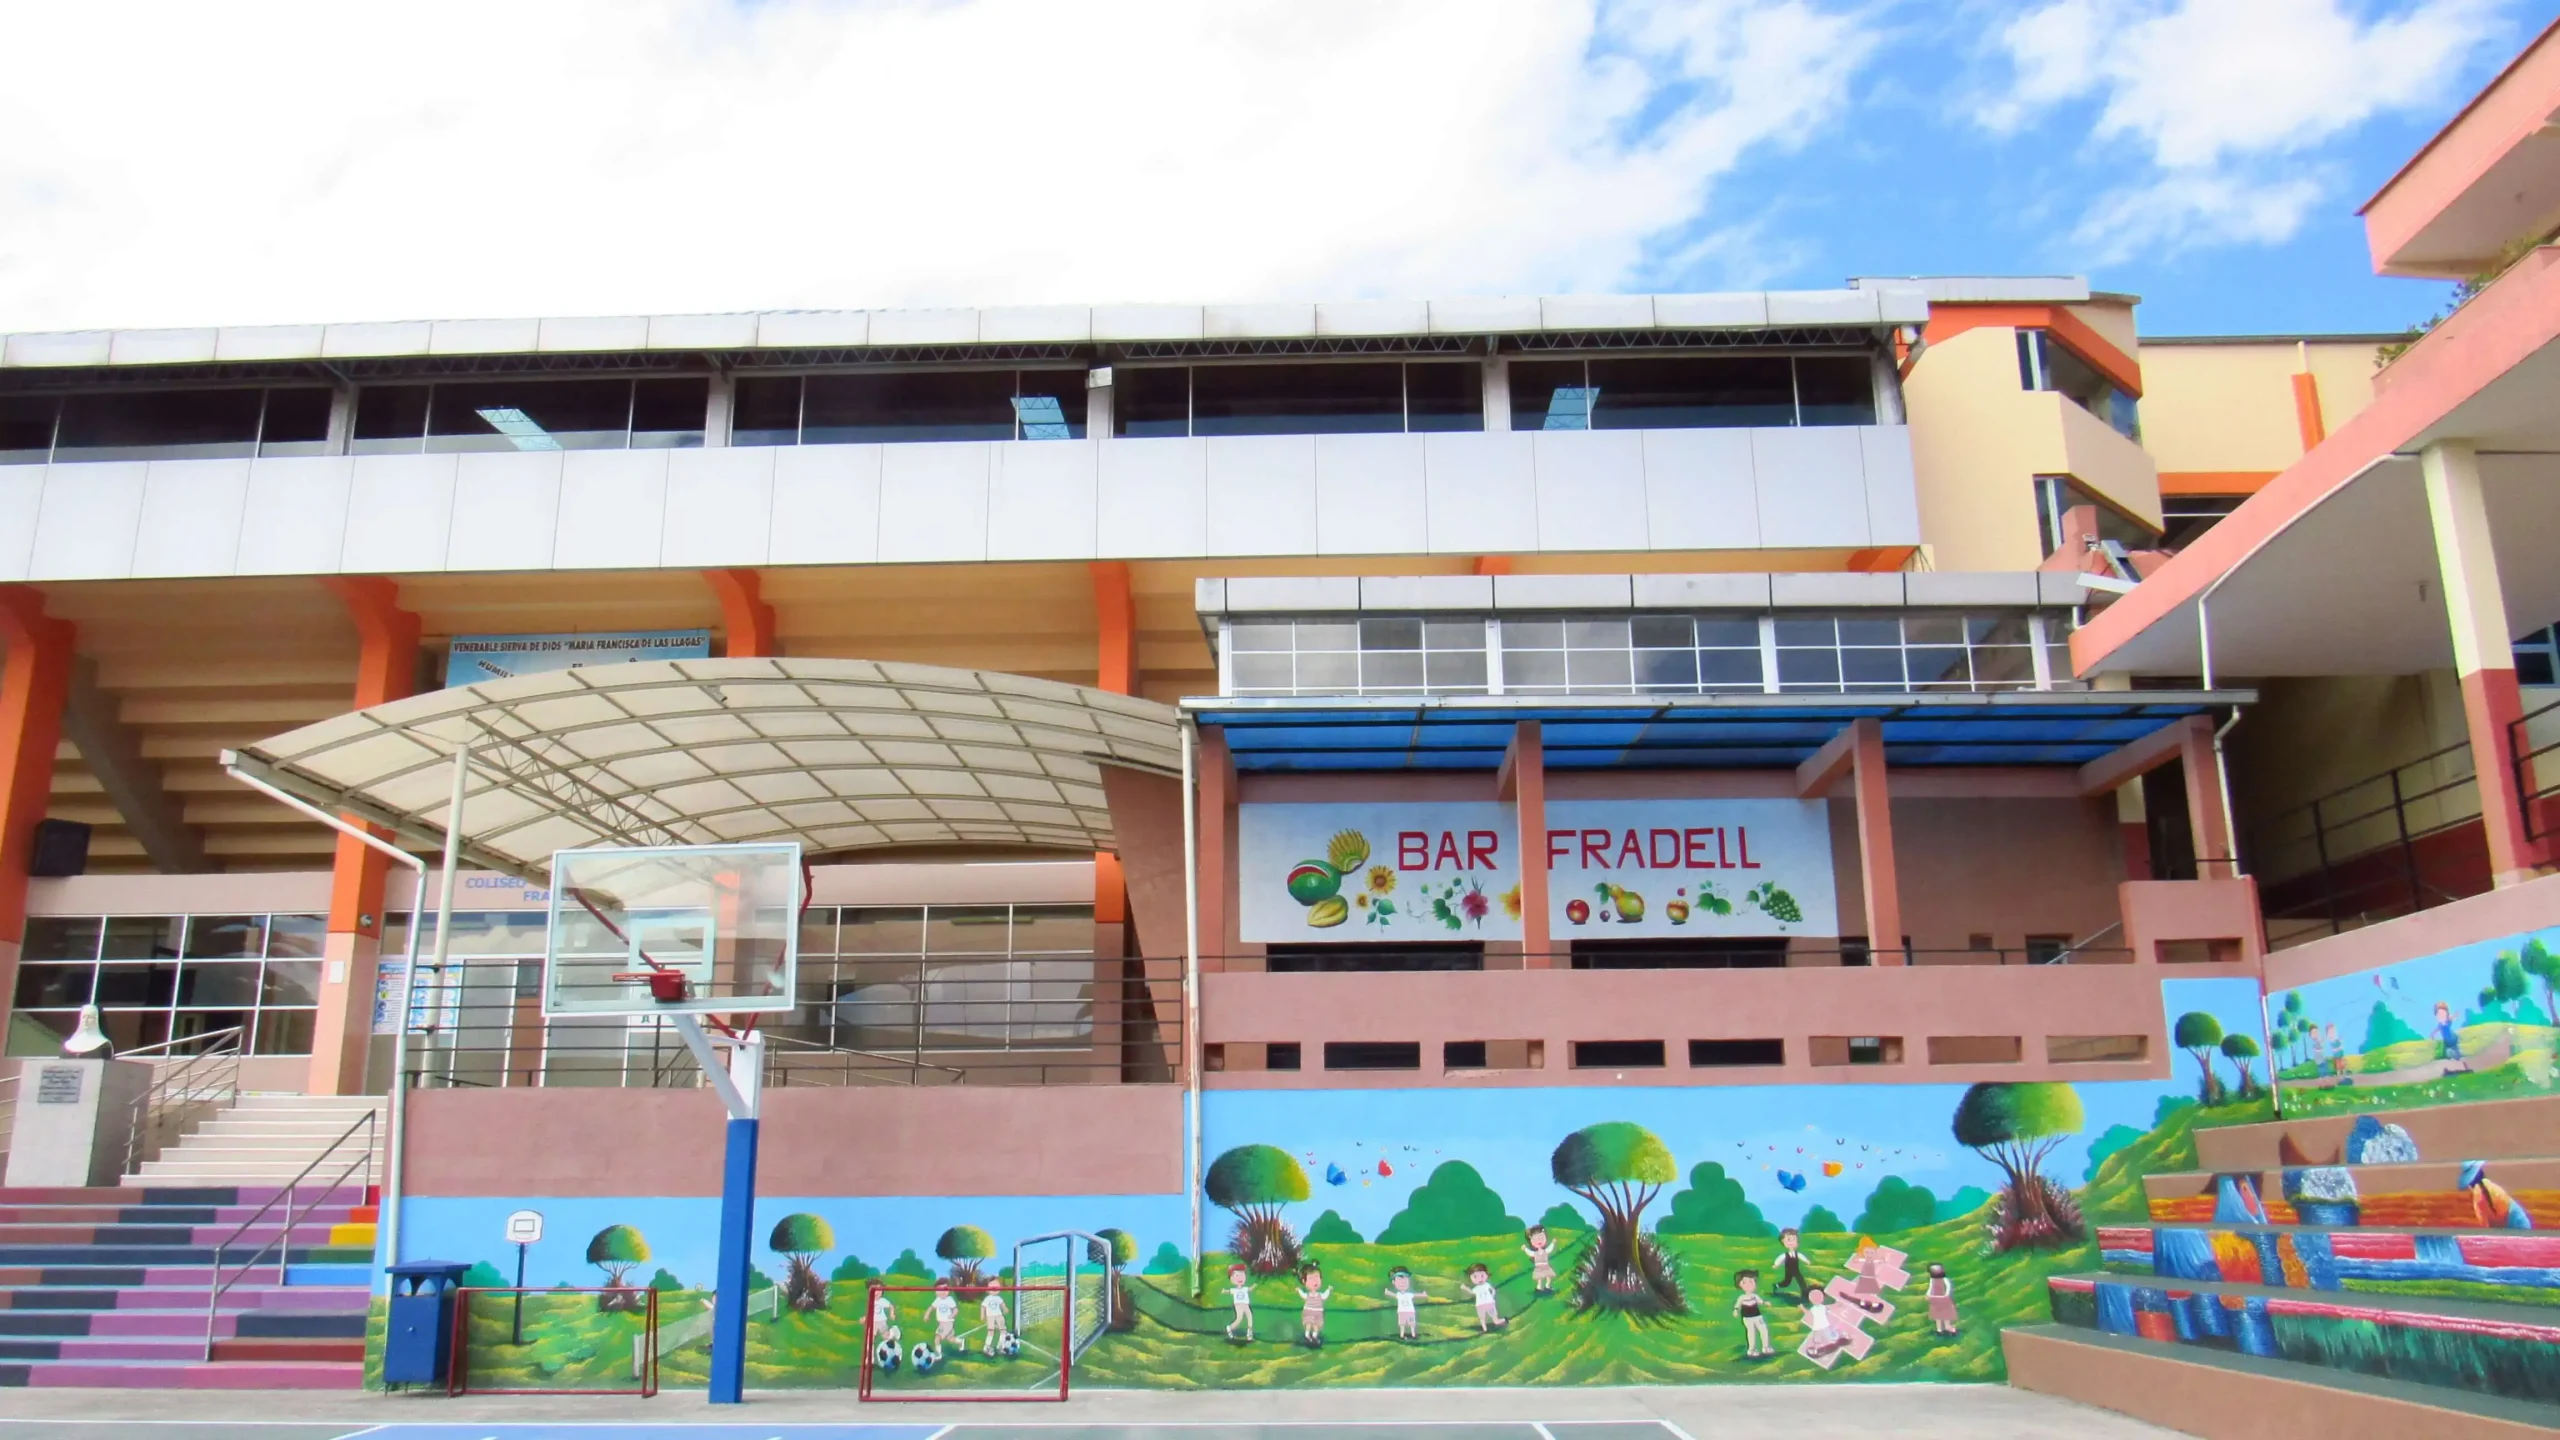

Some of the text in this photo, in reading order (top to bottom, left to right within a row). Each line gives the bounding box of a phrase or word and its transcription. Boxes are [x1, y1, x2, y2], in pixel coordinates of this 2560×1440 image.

[454, 642, 498, 652] VENERABLE
[500, 642, 526, 652] SIERVA
[529, 641, 540, 651] DE
[542, 641, 561, 651] DIOS
[597, 639, 639, 650] FRANCISCA
[641, 638, 652, 648] DE
[655, 638, 669, 648] LAS
[478, 660, 515, 678] HUMIL
[1398, 827, 1761, 871] BAR FRADELL
[465, 877, 527, 888] COLISEO
